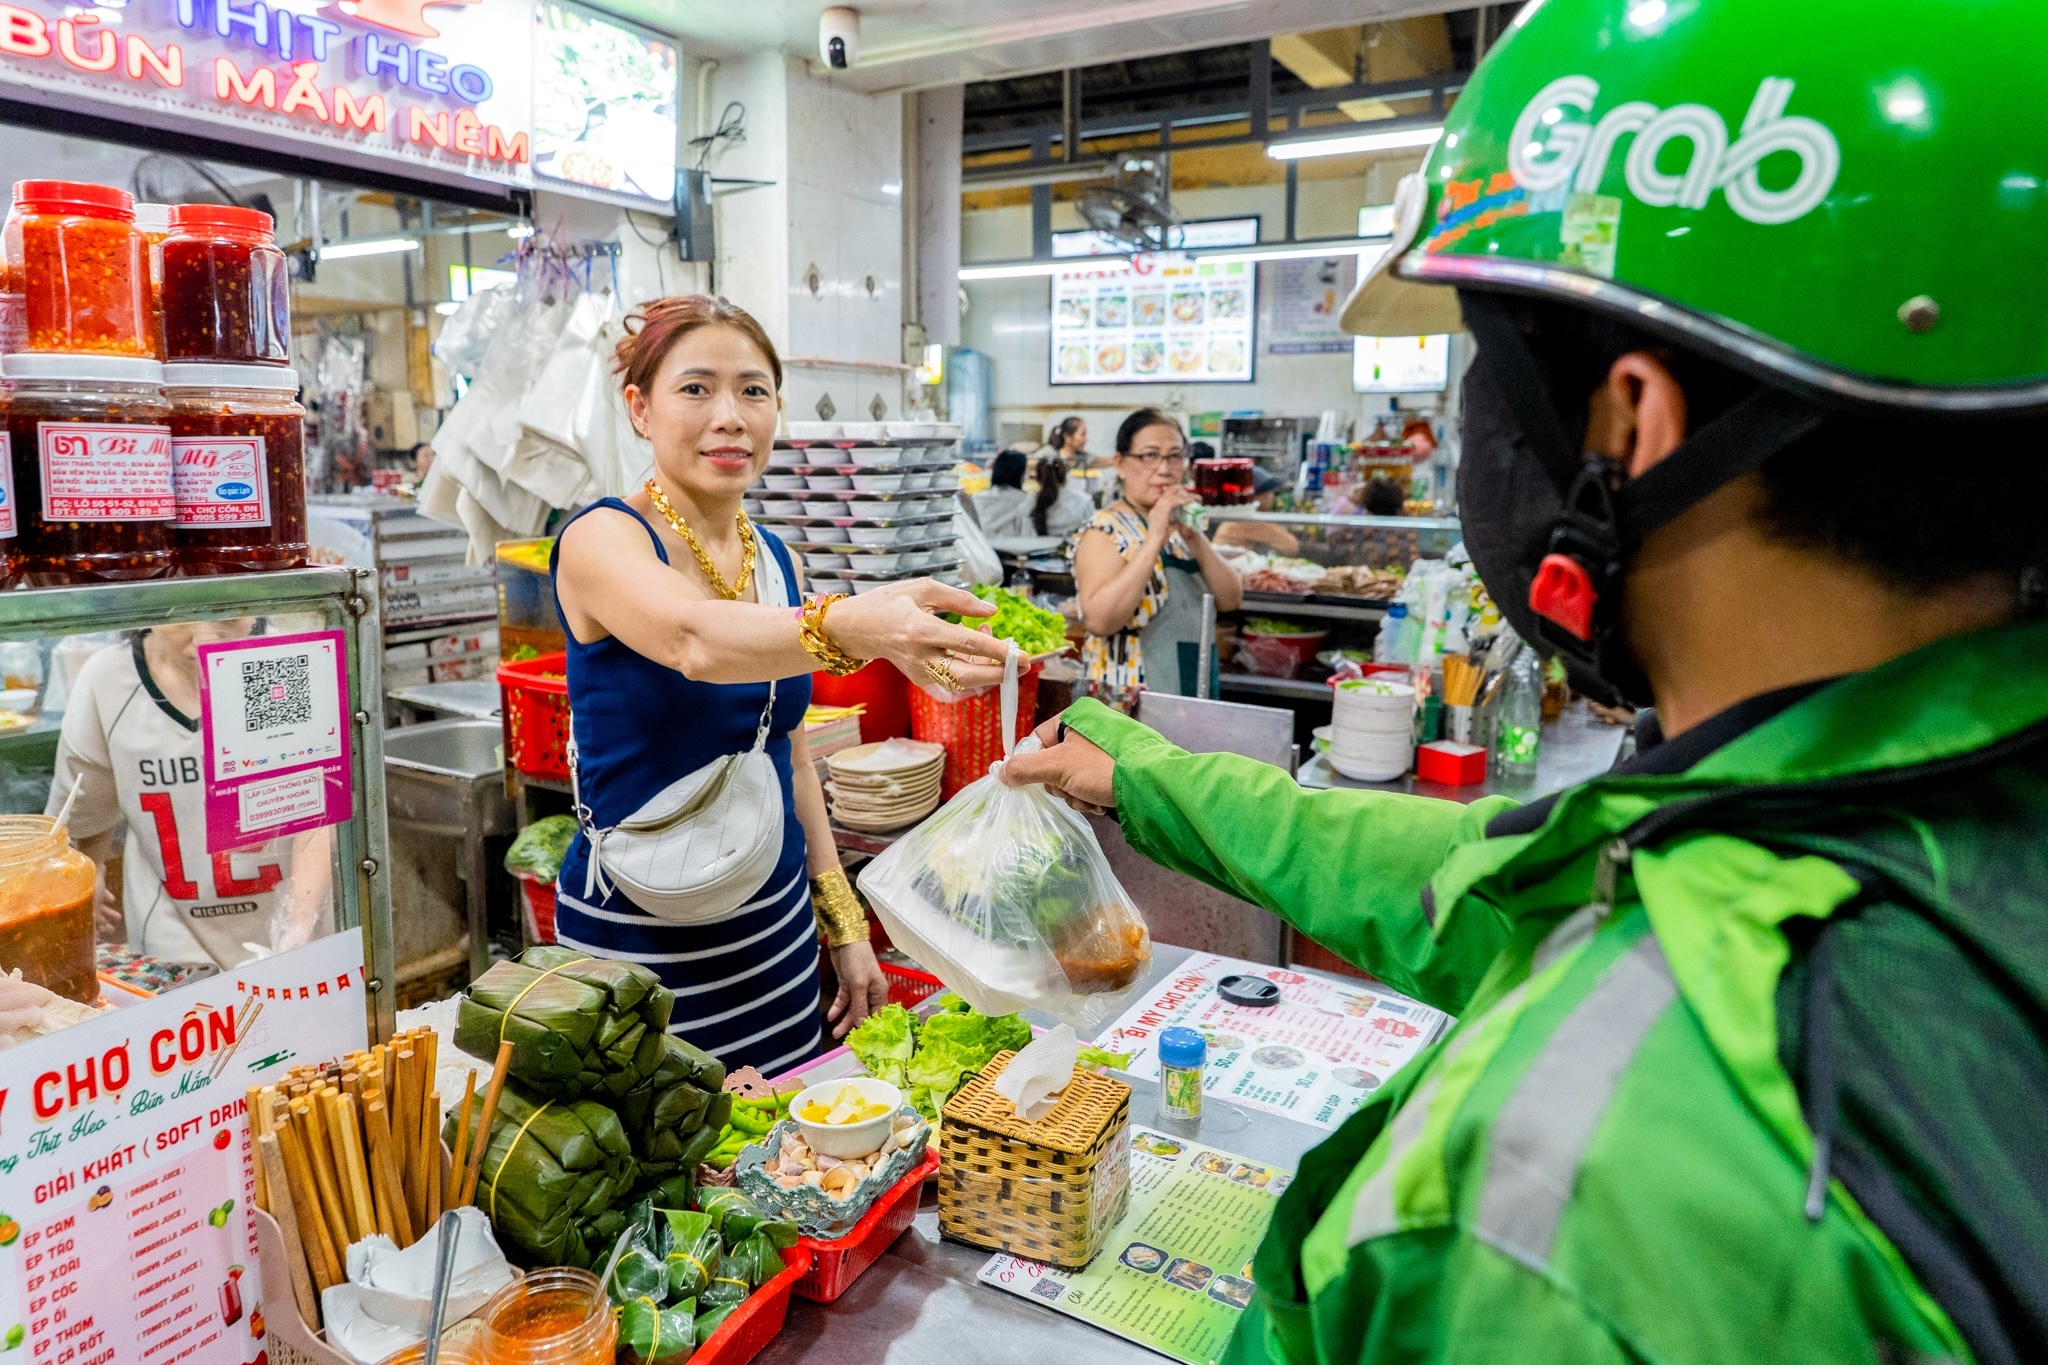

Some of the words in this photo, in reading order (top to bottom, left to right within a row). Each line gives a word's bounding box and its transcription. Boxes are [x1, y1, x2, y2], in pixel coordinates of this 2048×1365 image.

[365, 32, 494, 104] HEO
[409, 105, 529, 164] NÊM
[1508, 74, 1841, 225] Grab
[99, 436, 138, 455] Bi
[176, 449, 222, 468] Mỹ
[139, 756, 200, 787] SUB
[262, 787, 276, 796] LOA
[192, 902, 254, 918] MICHIGAN
[1125, 1026, 1148, 1039] BI
[33, 1038, 130, 1120] CHỢ
[149, 1002, 237, 1074] CỒN
[1214, 1052, 1240, 1068] 50.000
[1295, 1071, 1318, 1088] 30.000
[69, 1110, 107, 1141] Heo
[130, 1089, 165, 1117] Bún
[34, 1168, 76, 1205] GIẢI
[83, 1143, 136, 1185] KHÁT
[156, 1115, 203, 1151] SOFT
[130, 1178, 158, 1197] ORANGE
[161, 1168, 181, 1182] JUICE
[132, 1201, 154, 1217] APPLE
[157, 1190, 177, 1205] JUICE
[24, 1230, 41, 1249] ÉP
[46, 1215, 75, 1239] CAM
[134, 1220, 159, 1238] MANGO
[161, 1210, 181, 1224] JUICE
[180, 1221, 199, 1236] JUICE
[26, 1252, 43, 1271] ÉP
[47, 1237, 74, 1260] TÁO
[137, 1261, 160, 1278] GUAVA
[162, 1250, 182, 1264] JUICE
[28, 1274, 44, 1292] ÉP
[50, 1255, 80, 1282] XOÀI
[138, 1272, 176, 1297] PINEAPPLE
[179, 1261, 198, 1276] JUICE
[985, 1264, 999, 1277] SINH
[30, 1295, 46, 1314] ÉP
[52, 1280, 78, 1302] CÓC
[140, 1298, 168, 1318] CARROT
[170, 1286, 190, 1302] JUICE
[32, 1316, 48, 1335] ÉP
[142, 1317, 172, 1338] TOMATO
[174, 1305, 193, 1321] JUICE
[34, 1338, 50, 1357] ÉP
[79, 1330, 104, 1354] RỐT
[144, 1326, 192, 1358] WATERMELON
[194, 1314, 212, 1330] JUICE
[177, 1344, 197, 1360] FRUIT
[200, 1332, 218, 1348] JUICE
